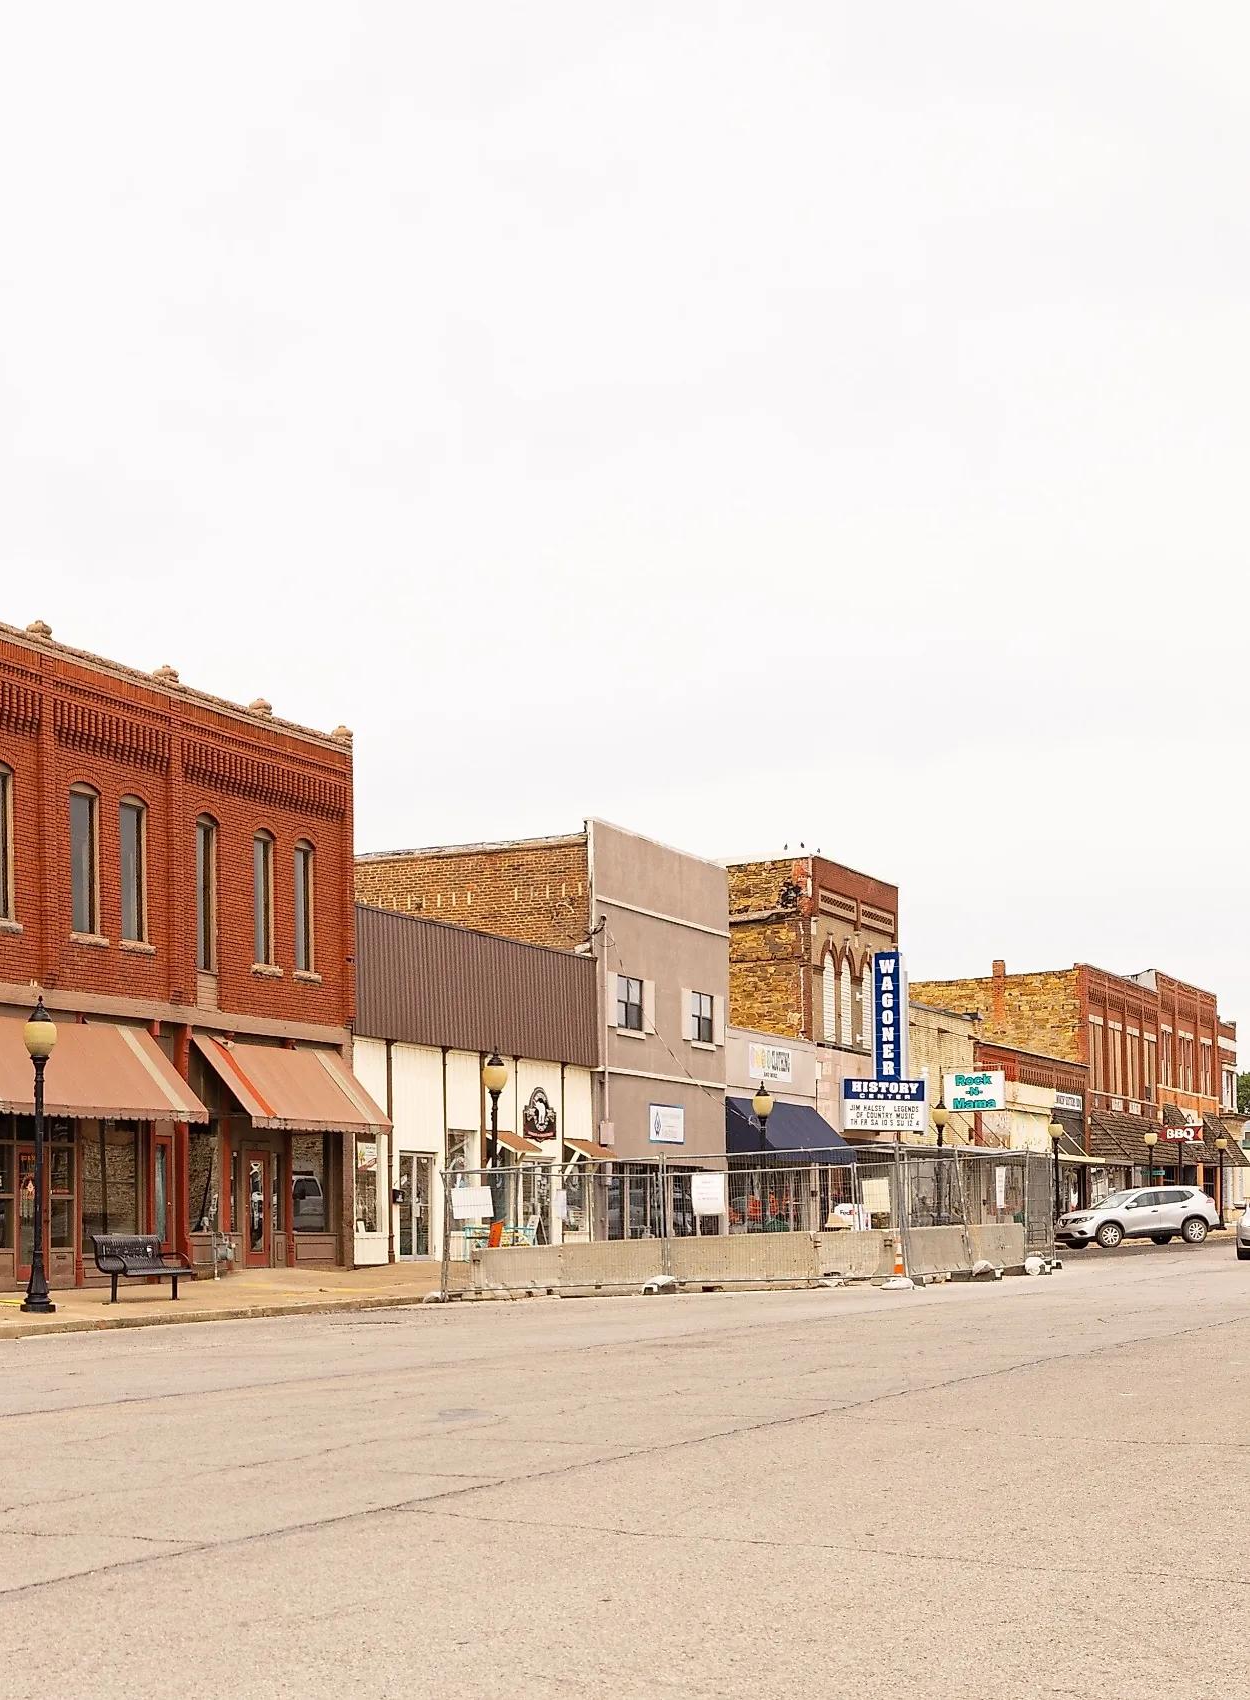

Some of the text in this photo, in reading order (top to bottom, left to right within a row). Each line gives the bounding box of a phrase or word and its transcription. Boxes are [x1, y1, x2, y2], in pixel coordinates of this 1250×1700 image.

[879, 959, 895, 1076] WAGONER
[955, 1074, 993, 1086] Rock
[851, 1081, 919, 1094] HISTORY
[953, 1097, 997, 1109] Mama
[1166, 1128, 1195, 1140] BBQ
